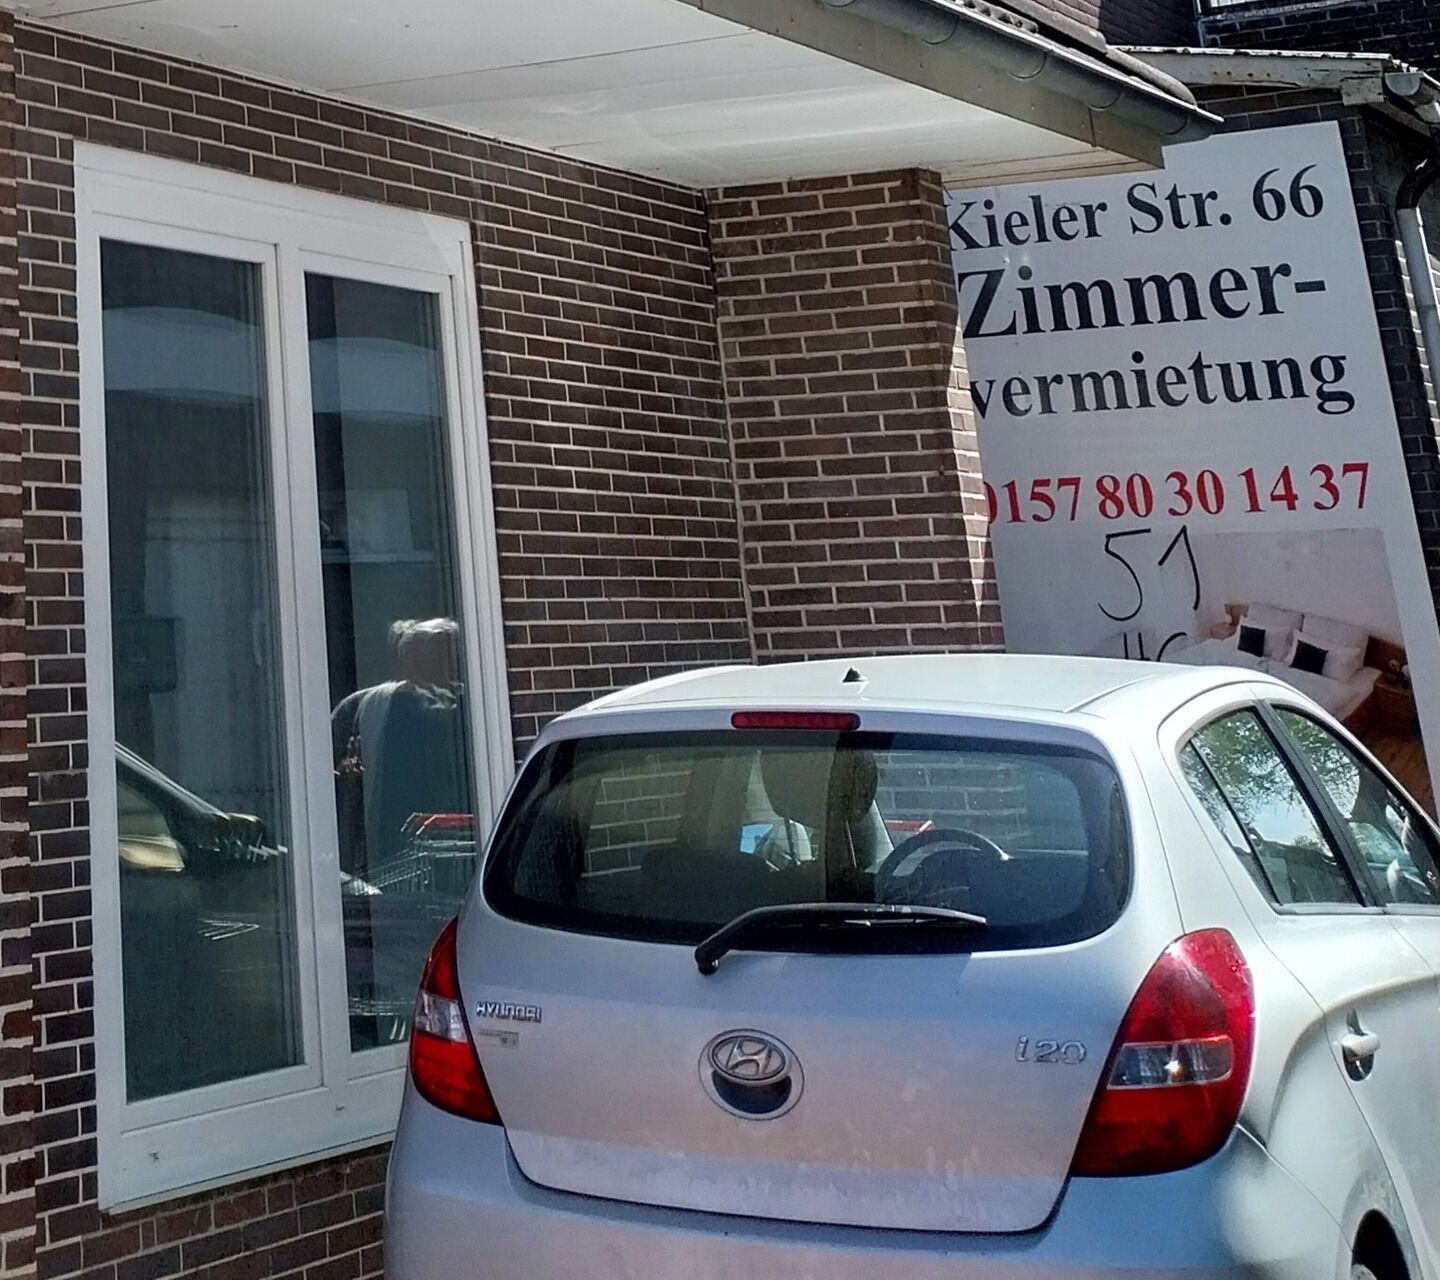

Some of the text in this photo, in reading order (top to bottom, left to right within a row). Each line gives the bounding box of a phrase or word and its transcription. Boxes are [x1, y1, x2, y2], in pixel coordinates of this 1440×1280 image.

[945, 164, 1324, 252] Kieler Str. 66
[958, 263, 1327, 339] Zimmer-
[969, 350, 1356, 420] vermietung
[1095, 472, 1154, 520] 80
[1165, 468, 1225, 517] 30
[1237, 465, 1299, 513] 14
[1310, 462, 1369, 511] 37
[476, 1001, 542, 1024] HYUNDAI
[1015, 1034, 1087, 1065] i20
